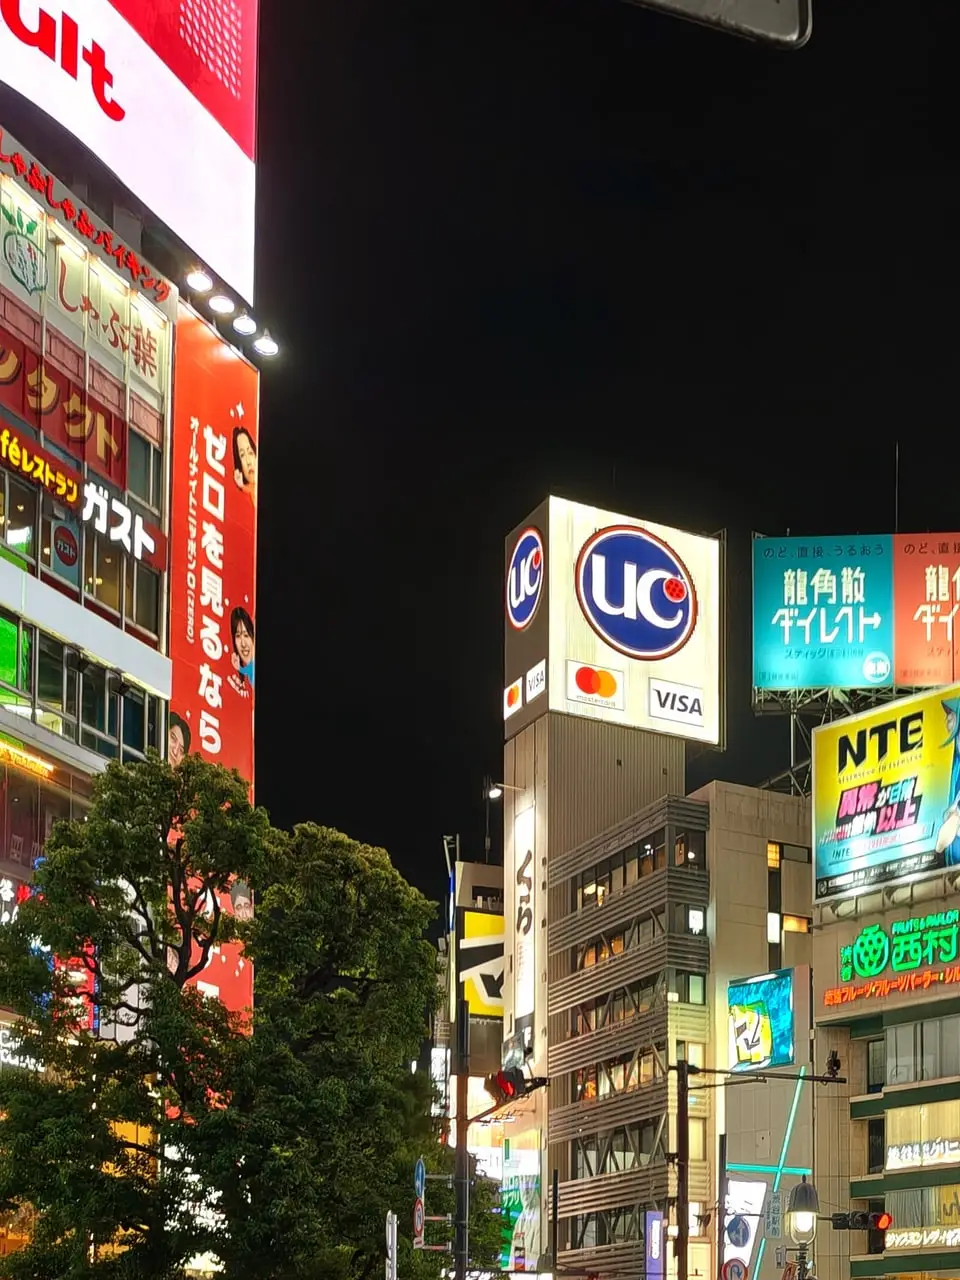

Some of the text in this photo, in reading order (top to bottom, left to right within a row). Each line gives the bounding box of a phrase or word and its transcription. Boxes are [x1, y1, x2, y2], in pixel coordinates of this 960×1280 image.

[82, 481, 155, 561] ガスト
[198, 424, 227, 755] ゼロを見るなら
[783, 566, 866, 606] 龍角散
[771, 605, 882, 645] ダイレクト
[528, 669, 545, 692] VISA
[653, 688, 703, 717] VISA
[837, 710, 924, 775] NTE
[890, 923, 960, 973] 西村
